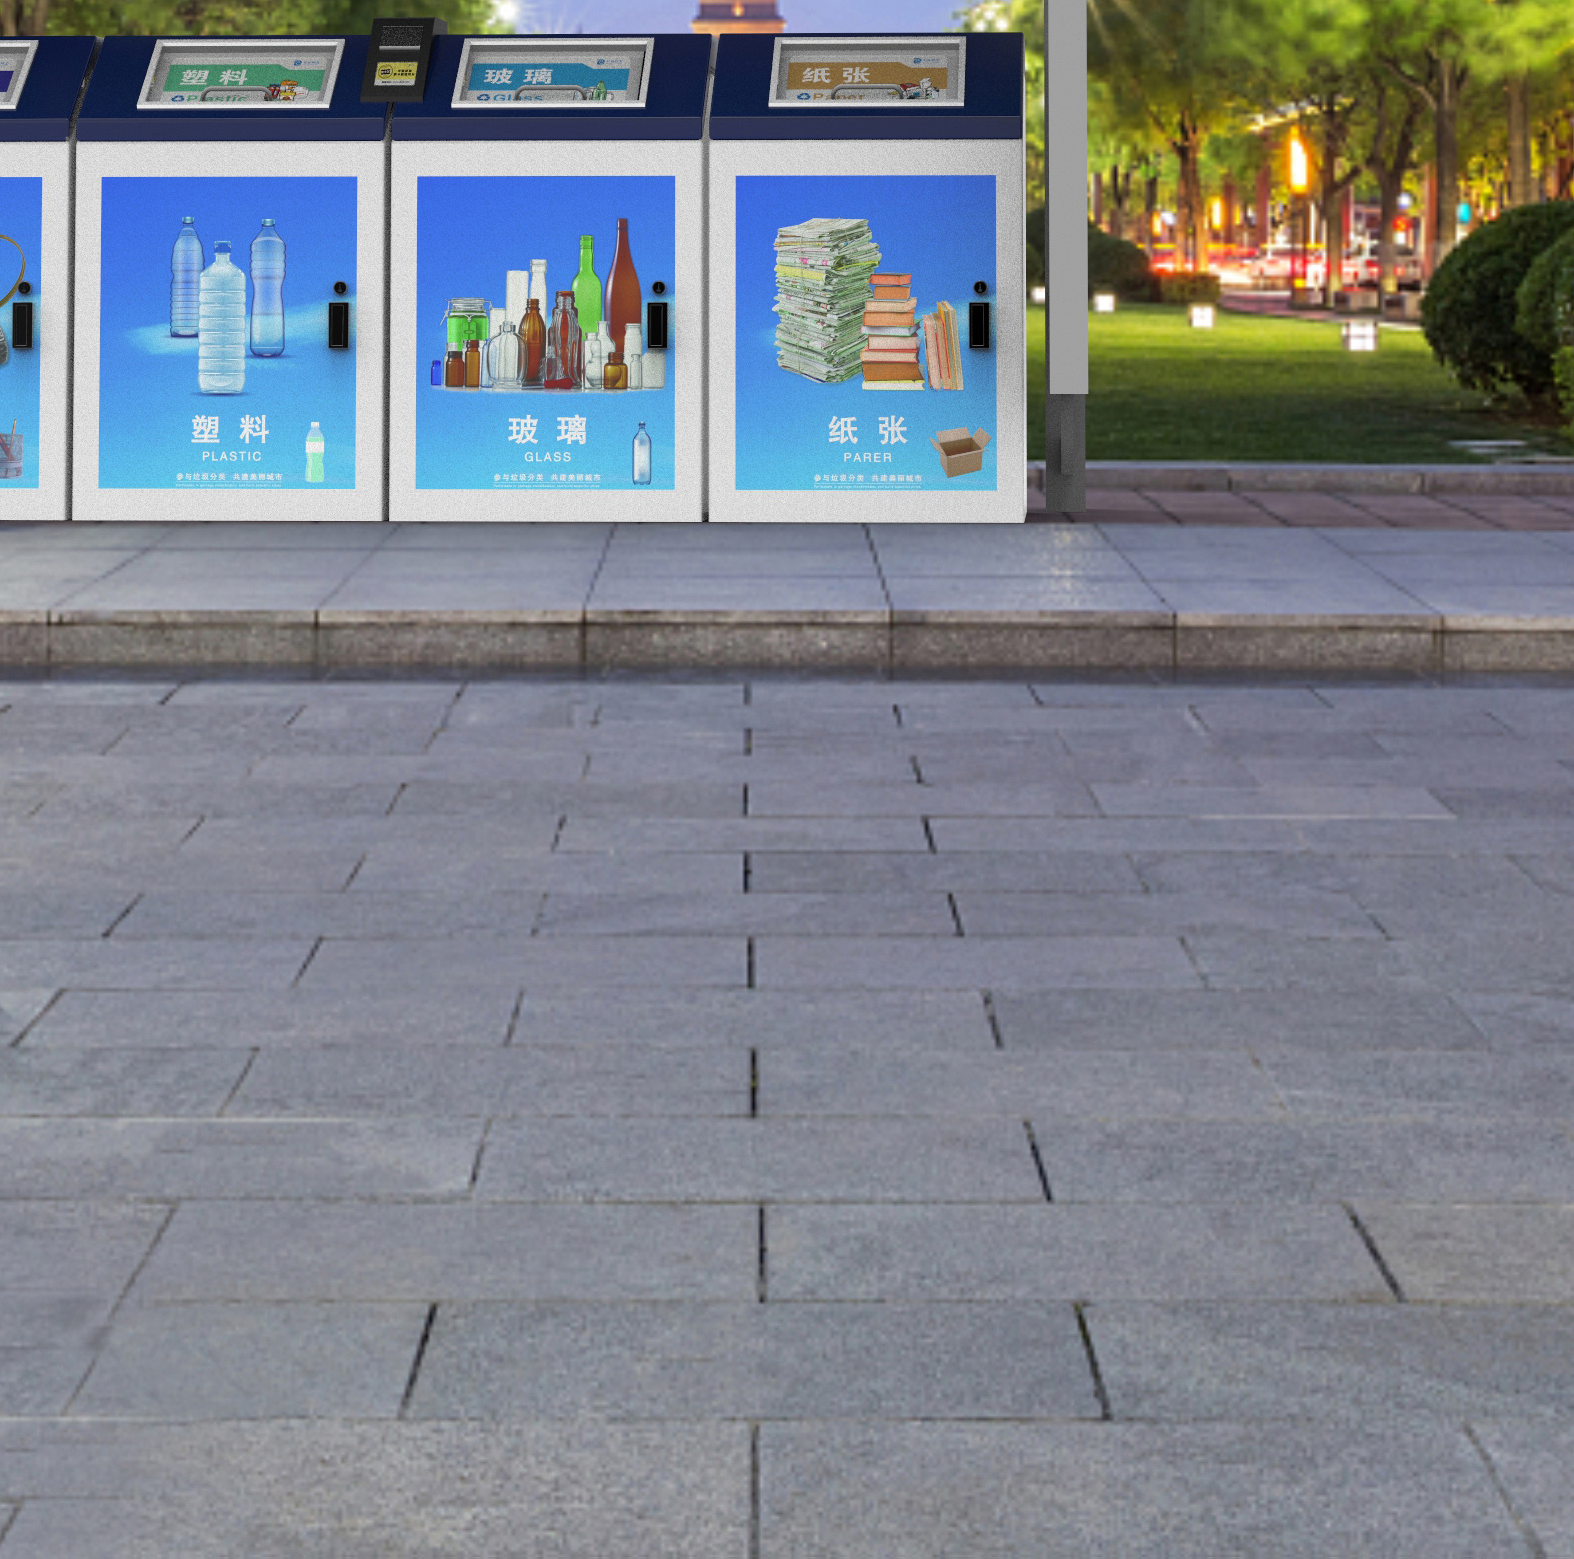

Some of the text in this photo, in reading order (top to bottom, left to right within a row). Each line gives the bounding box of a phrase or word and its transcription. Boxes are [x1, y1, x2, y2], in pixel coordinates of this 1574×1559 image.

[179, 69, 248, 86] 塑料
[483, 68, 553, 85] 玻璃
[801, 66, 870, 84] 纸张
[186, 94, 247, 102] Pastic
[191, 414, 270, 444] 塑料
[508, 414, 587, 445] 玻璃
[828, 415, 908, 445] 纸张
[202, 451, 262, 462] PLASTIC
[524, 451, 572, 462] GLASS
